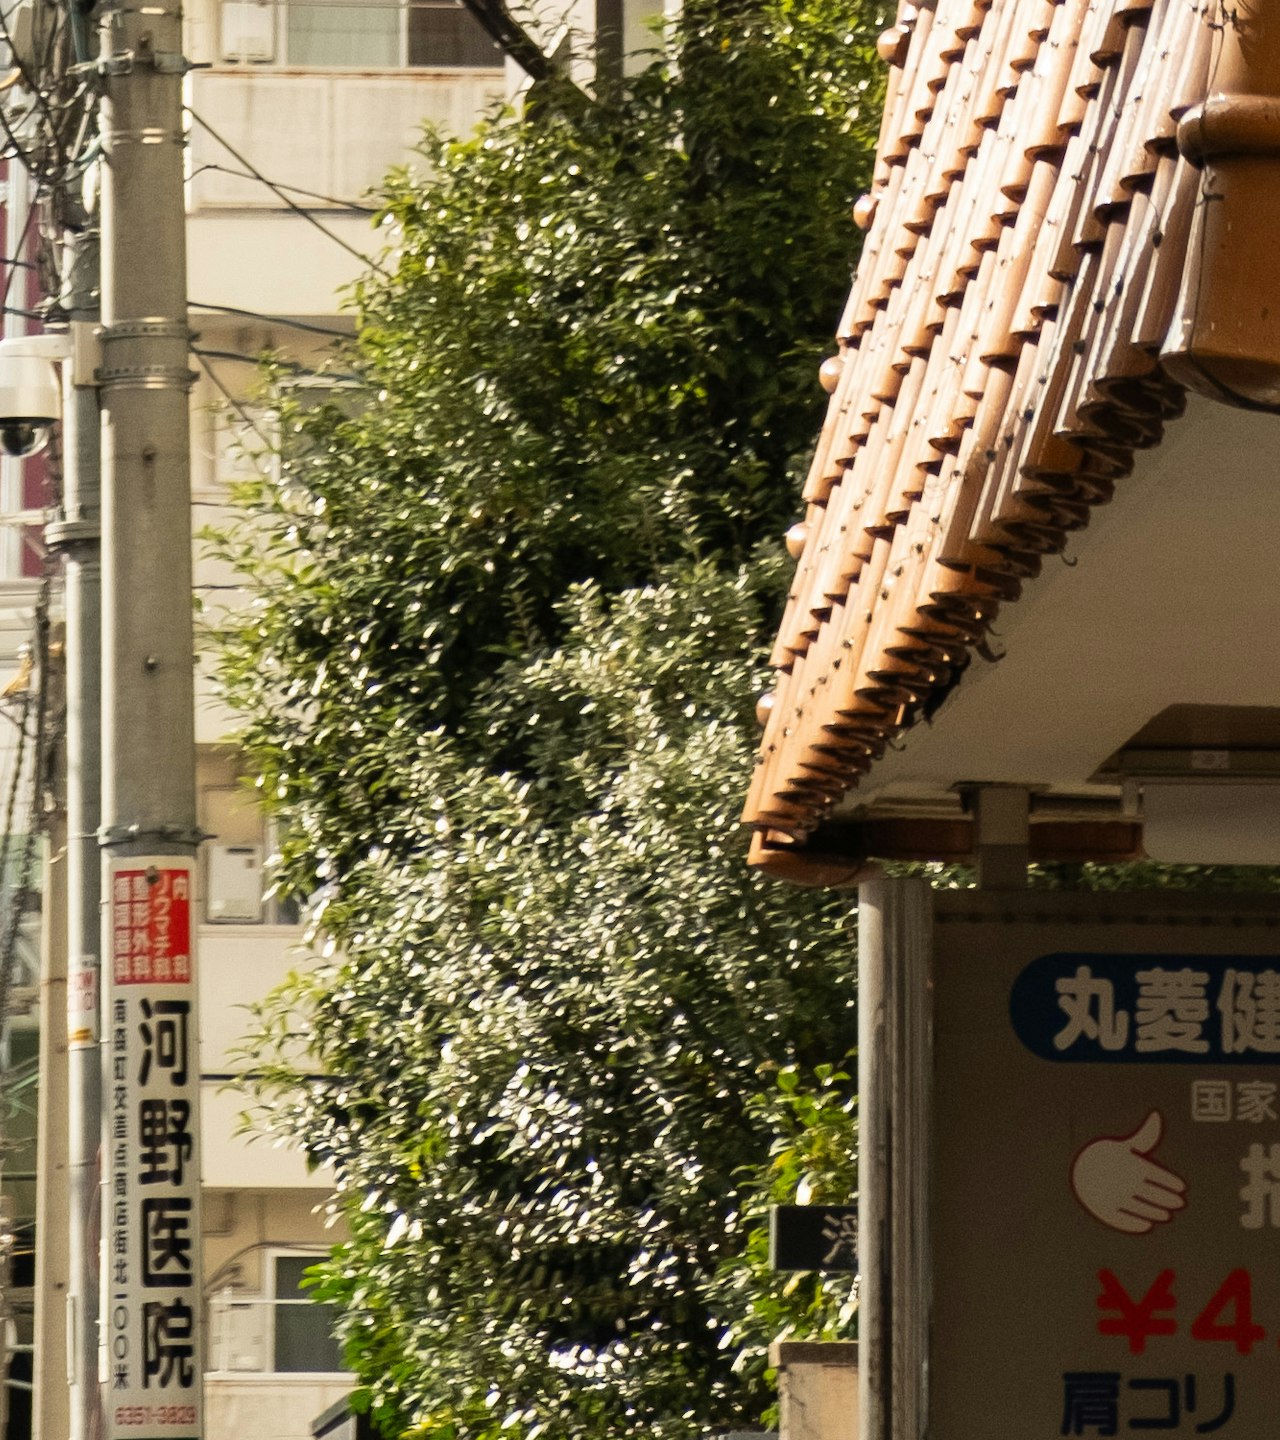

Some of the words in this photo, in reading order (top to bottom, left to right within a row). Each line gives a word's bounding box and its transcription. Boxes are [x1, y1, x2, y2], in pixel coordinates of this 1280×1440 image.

[138, 997, 195, 1389] 河野医院
[1061, 1372, 1234, 1436] 肩コリ
